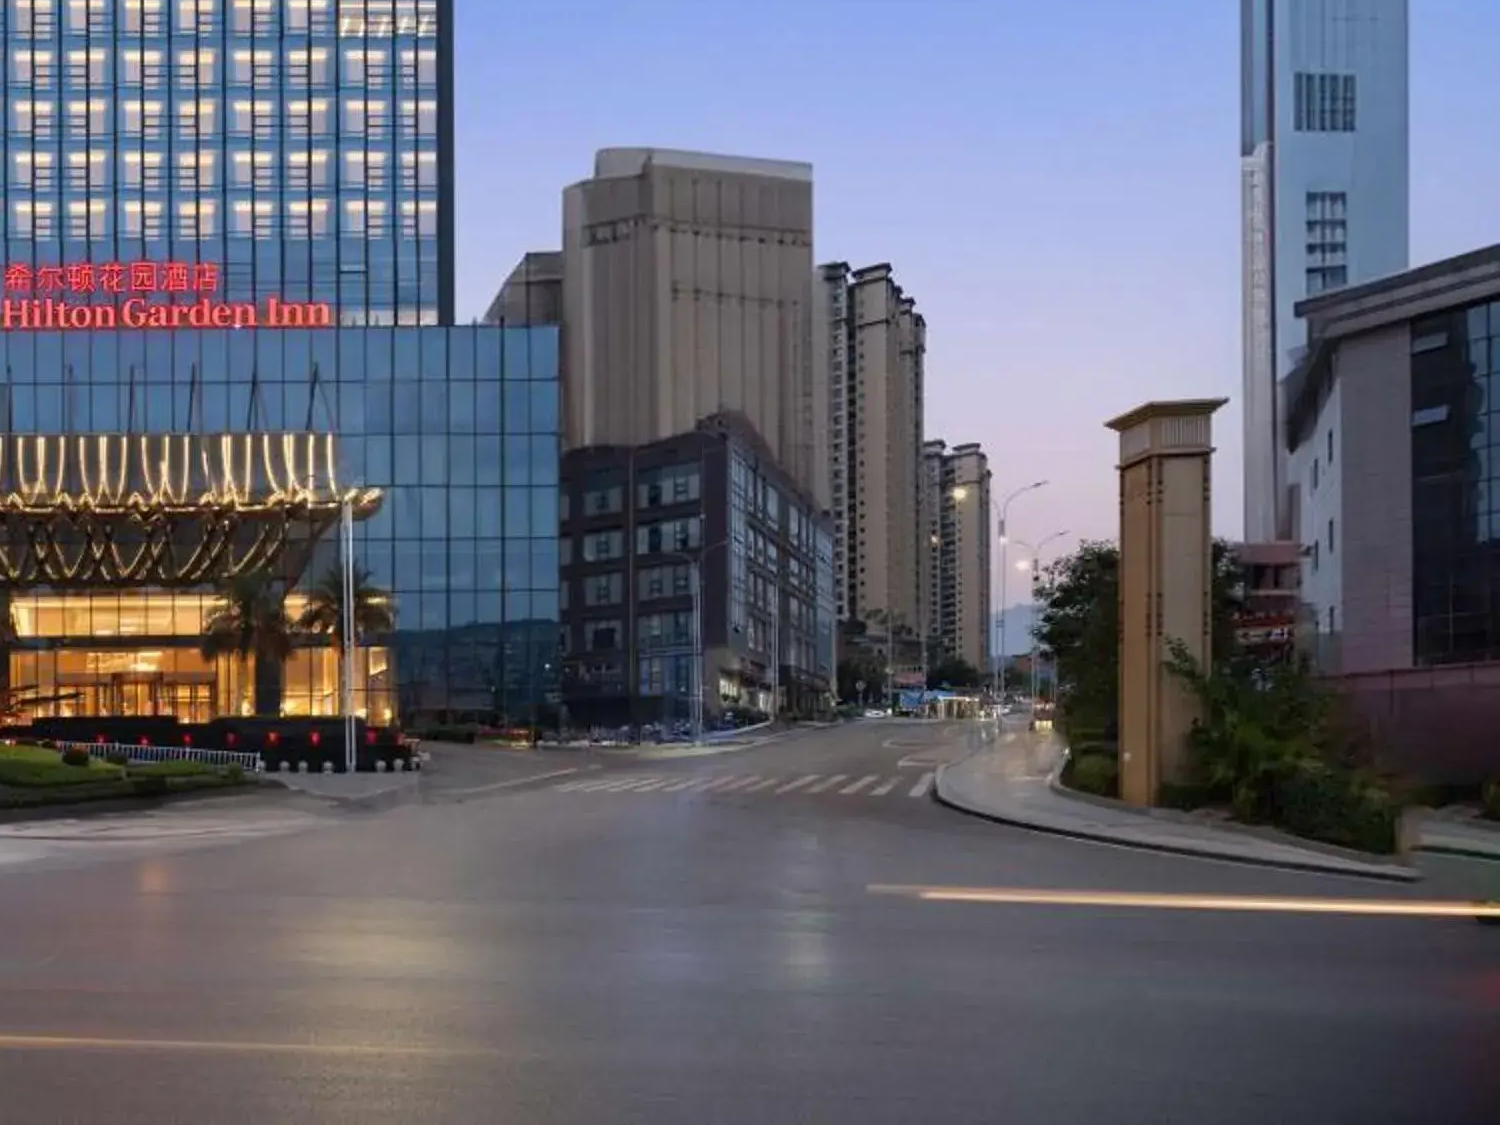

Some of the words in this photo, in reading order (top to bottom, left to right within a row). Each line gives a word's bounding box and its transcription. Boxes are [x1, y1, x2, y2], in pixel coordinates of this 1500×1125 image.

[4, 262, 220, 292] 希尔顿花园酒店
[3, 297, 115, 328] Hilton
[121, 297, 258, 328] Garden
[268, 297, 331, 328] Inn
